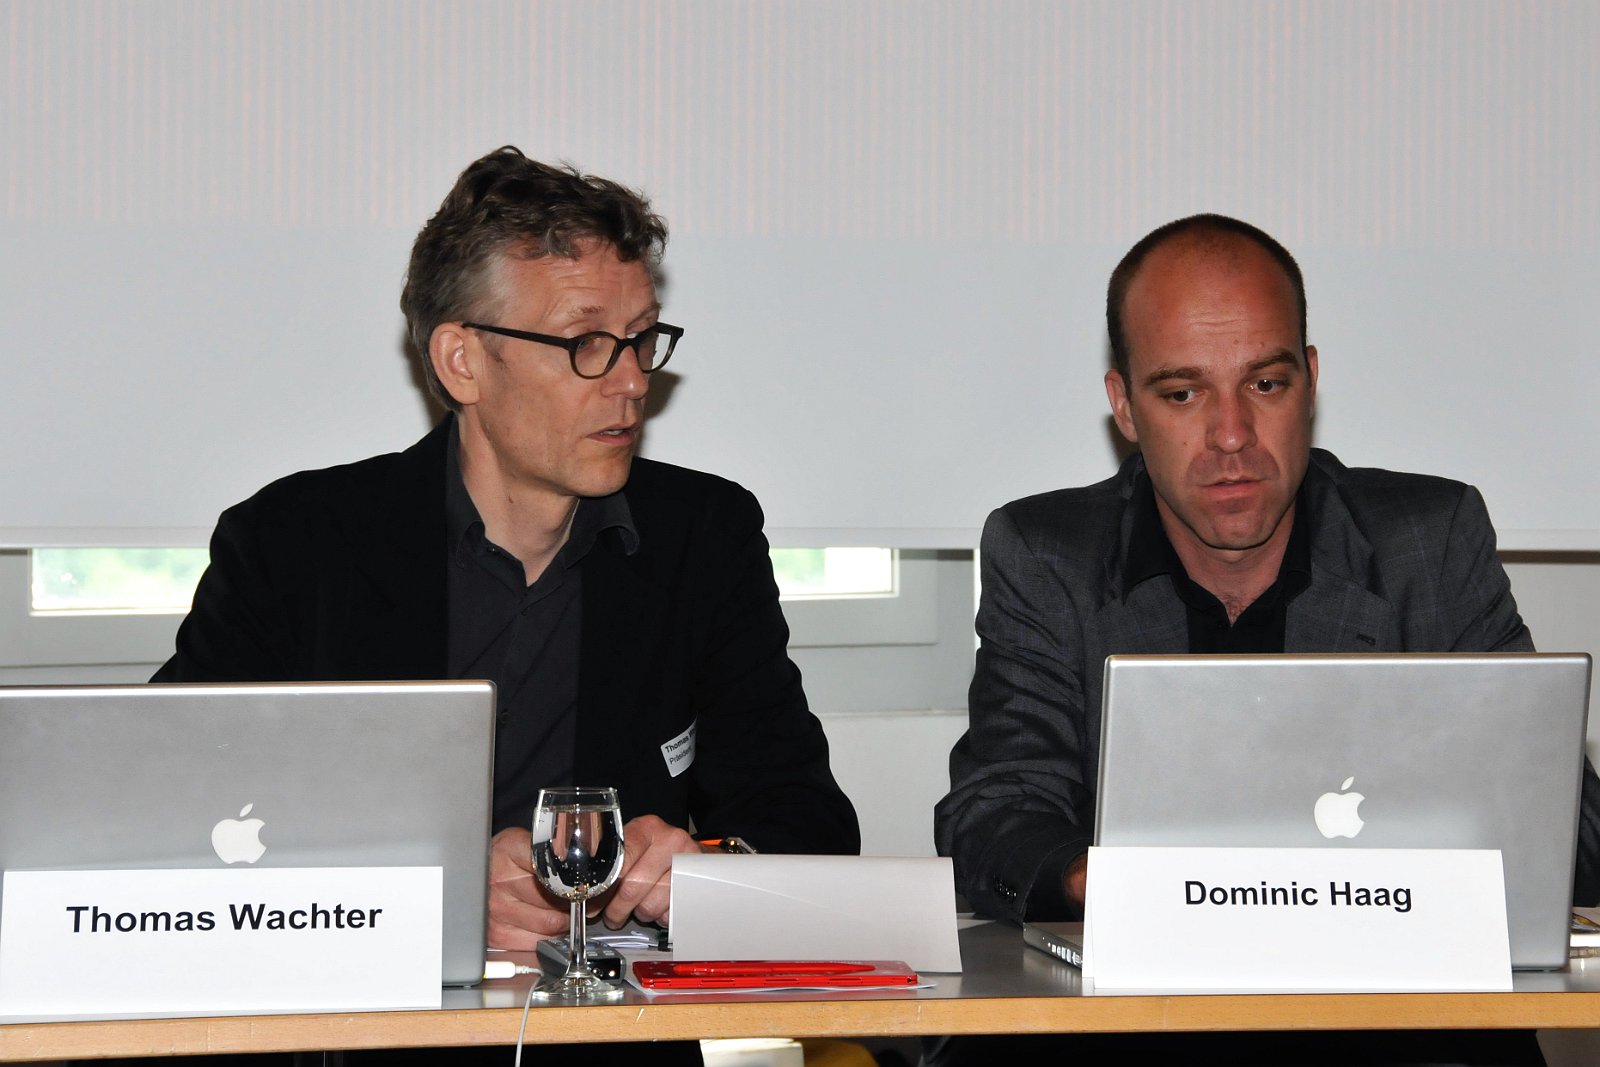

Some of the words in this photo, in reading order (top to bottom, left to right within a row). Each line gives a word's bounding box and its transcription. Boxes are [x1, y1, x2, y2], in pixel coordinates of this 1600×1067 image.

[665, 736, 689, 753] Thomas
[1184, 880, 1319, 906] Dominic
[1329, 881, 1412, 913] Haag
[66, 905, 216, 933] Thomas
[228, 902, 383, 931] Wachter
